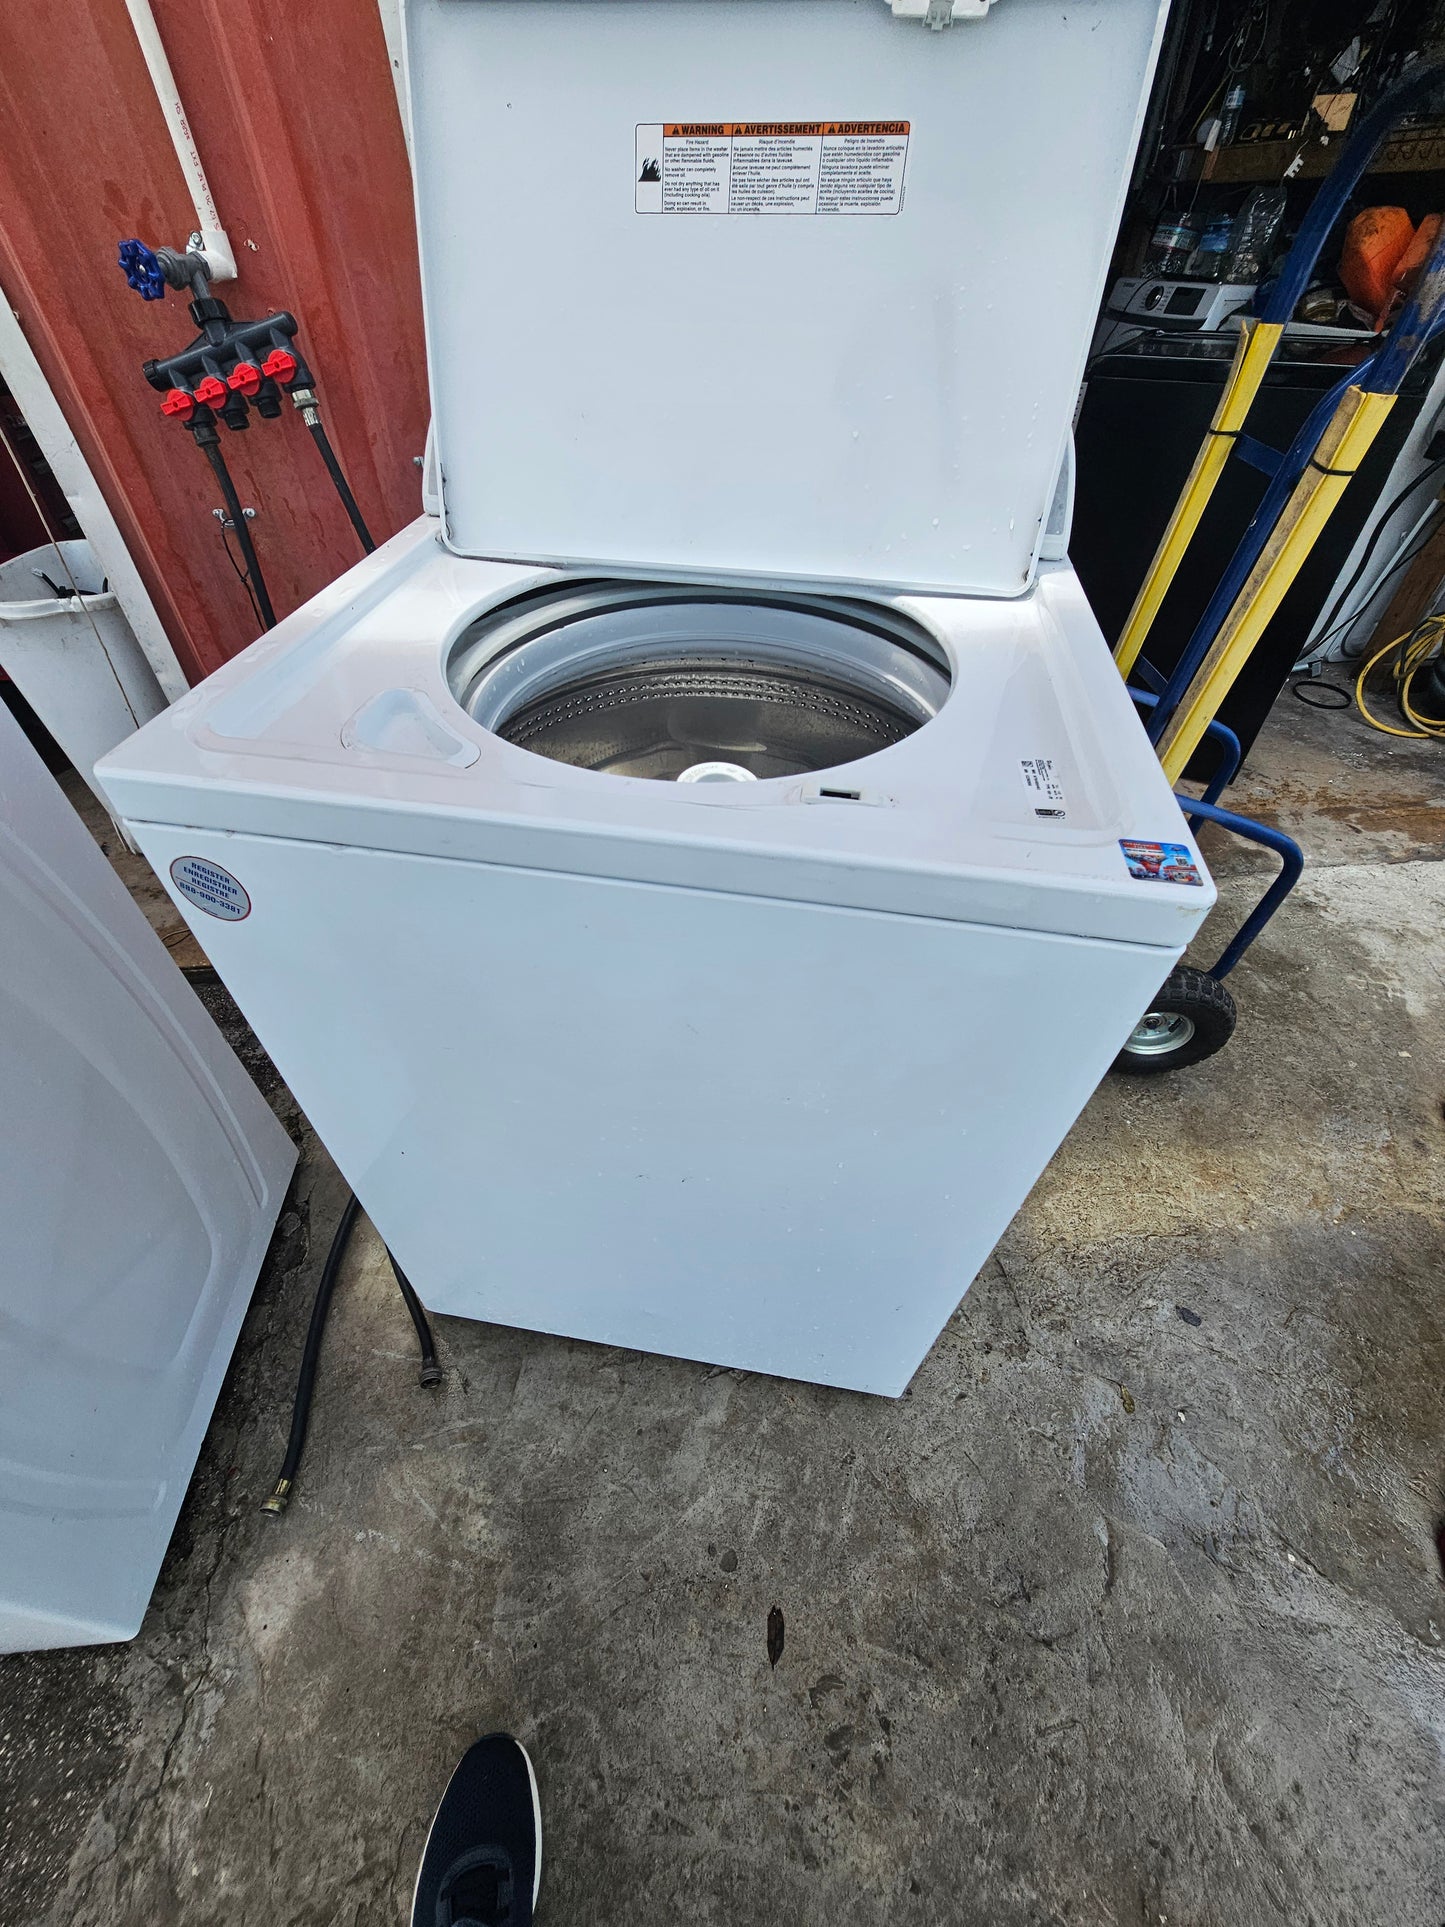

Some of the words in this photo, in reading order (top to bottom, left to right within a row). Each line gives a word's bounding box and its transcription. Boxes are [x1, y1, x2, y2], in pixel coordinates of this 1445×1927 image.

[682, 126, 724, 134] WARNING
[744, 124, 821, 134] AVERTISSEMENT
[838, 124, 904, 133] ADVERTENCIA
[183, 866, 238, 895] ENREGISTRER
[191, 862, 230, 884] REGISTER
[180, 882, 240, 914] 888-900-3381
[191, 877, 230, 899] REGISTRE
